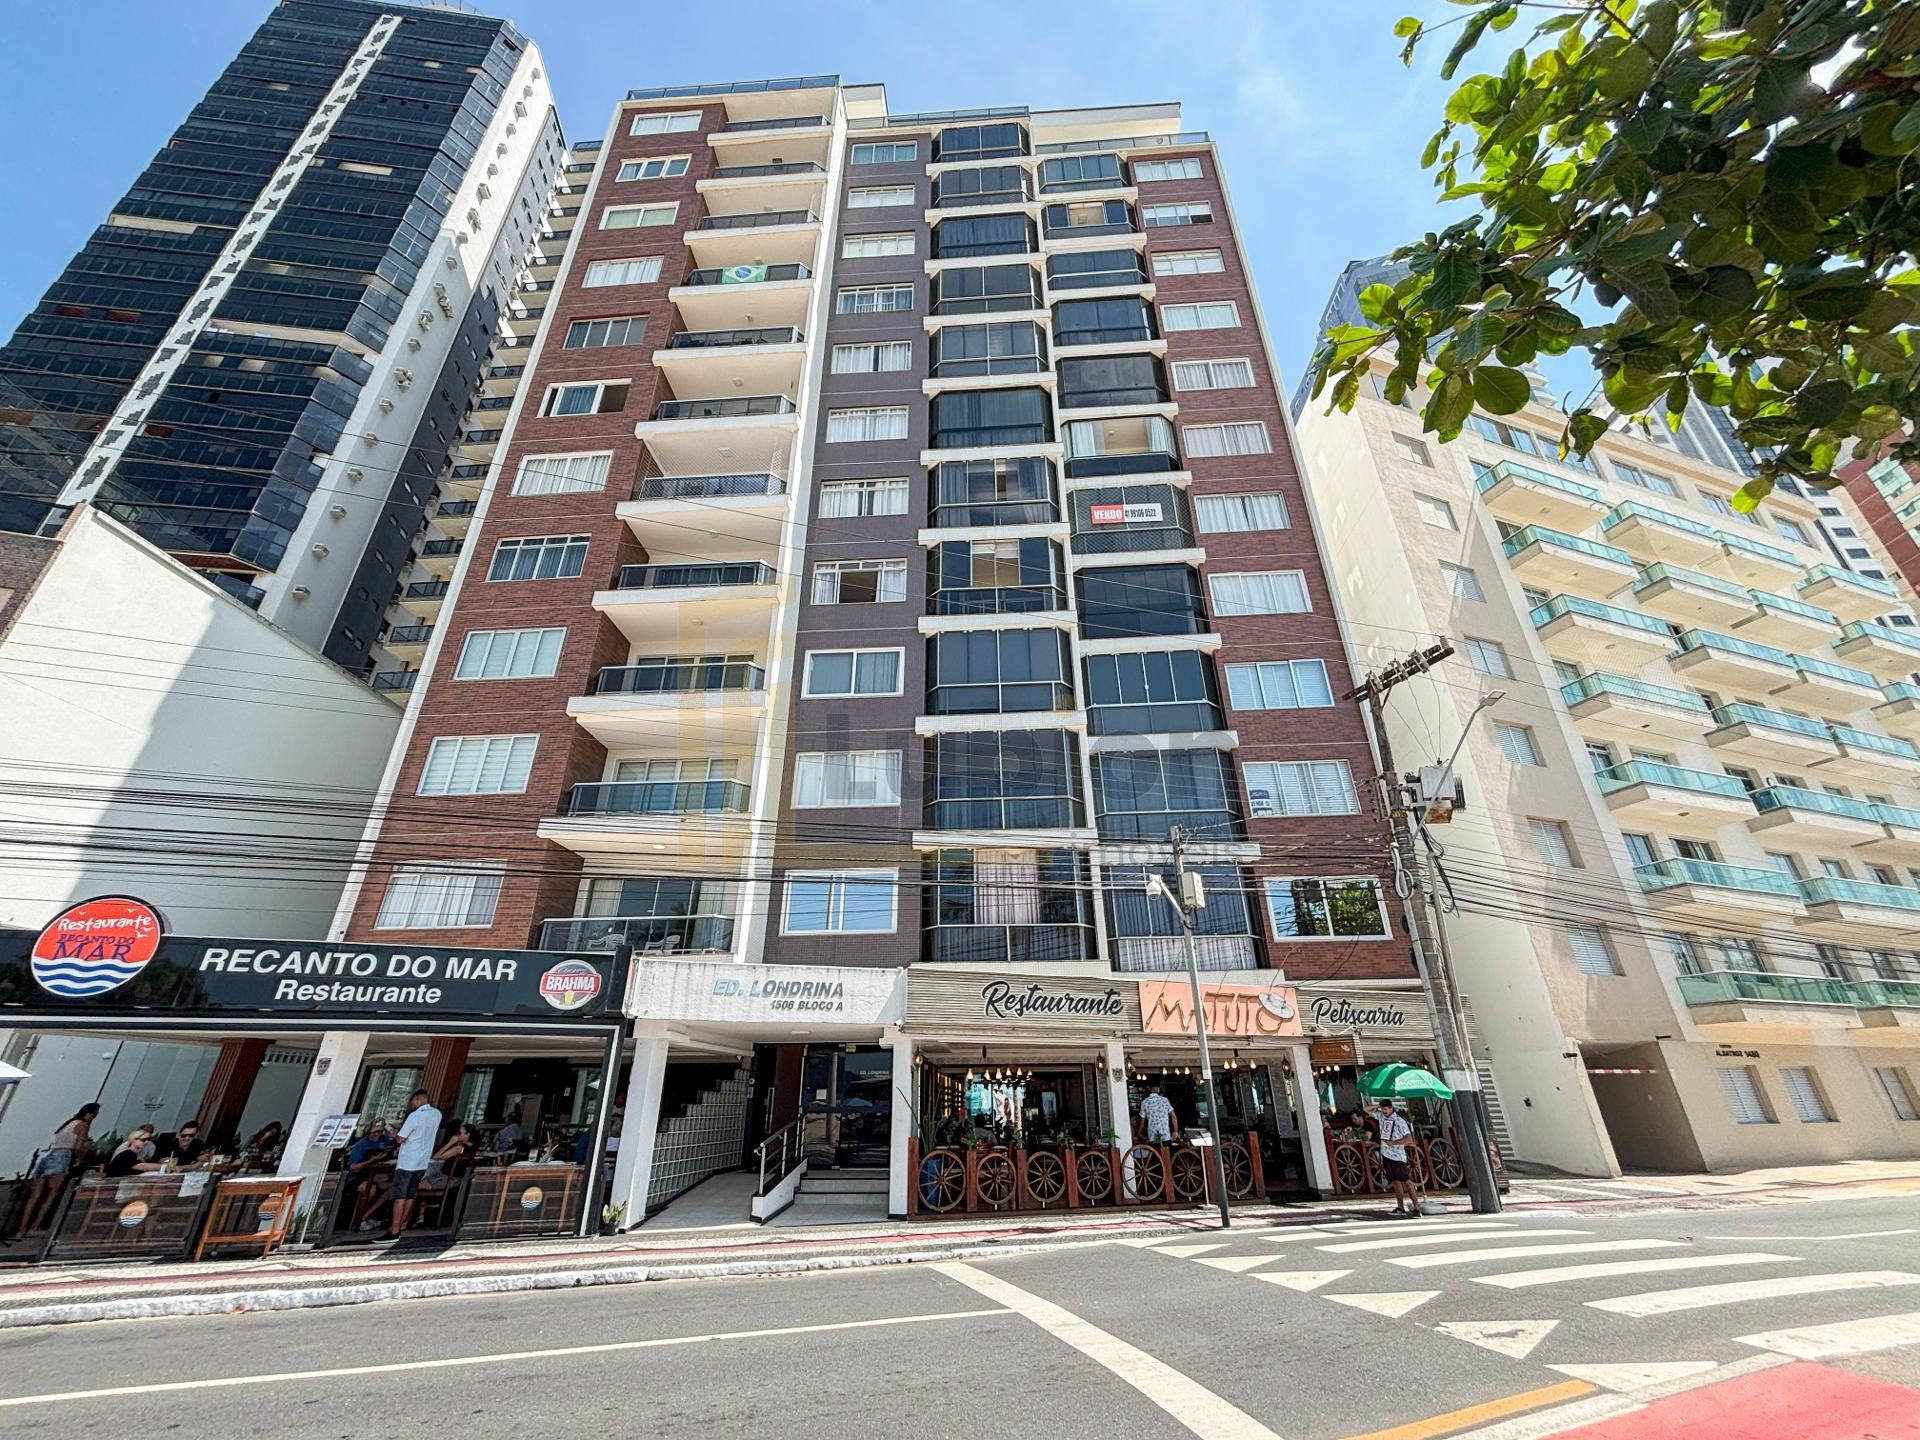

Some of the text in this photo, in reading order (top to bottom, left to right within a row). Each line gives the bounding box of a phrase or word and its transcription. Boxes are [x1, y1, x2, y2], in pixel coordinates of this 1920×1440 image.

[1093, 509, 1122, 520] VENDO
[58, 914, 152, 932] Restaurante
[58, 934, 135, 945] RECANTO DO
[50, 941, 132, 961] MAR
[199, 948, 518, 981] RECANTO DO MAR
[274, 979, 441, 1004] Restaurante
[545, 975, 595, 991] BRAHMA
[712, 978, 844, 999] ED. LONDRINA
[797, 1000, 834, 1012] BLOCO
[835, 1001, 844, 1012] A
[981, 980, 1125, 1018] Restaurante
[1145, 991, 1288, 1034] MATUTO
[1311, 997, 1405, 1026] Petiscaria
